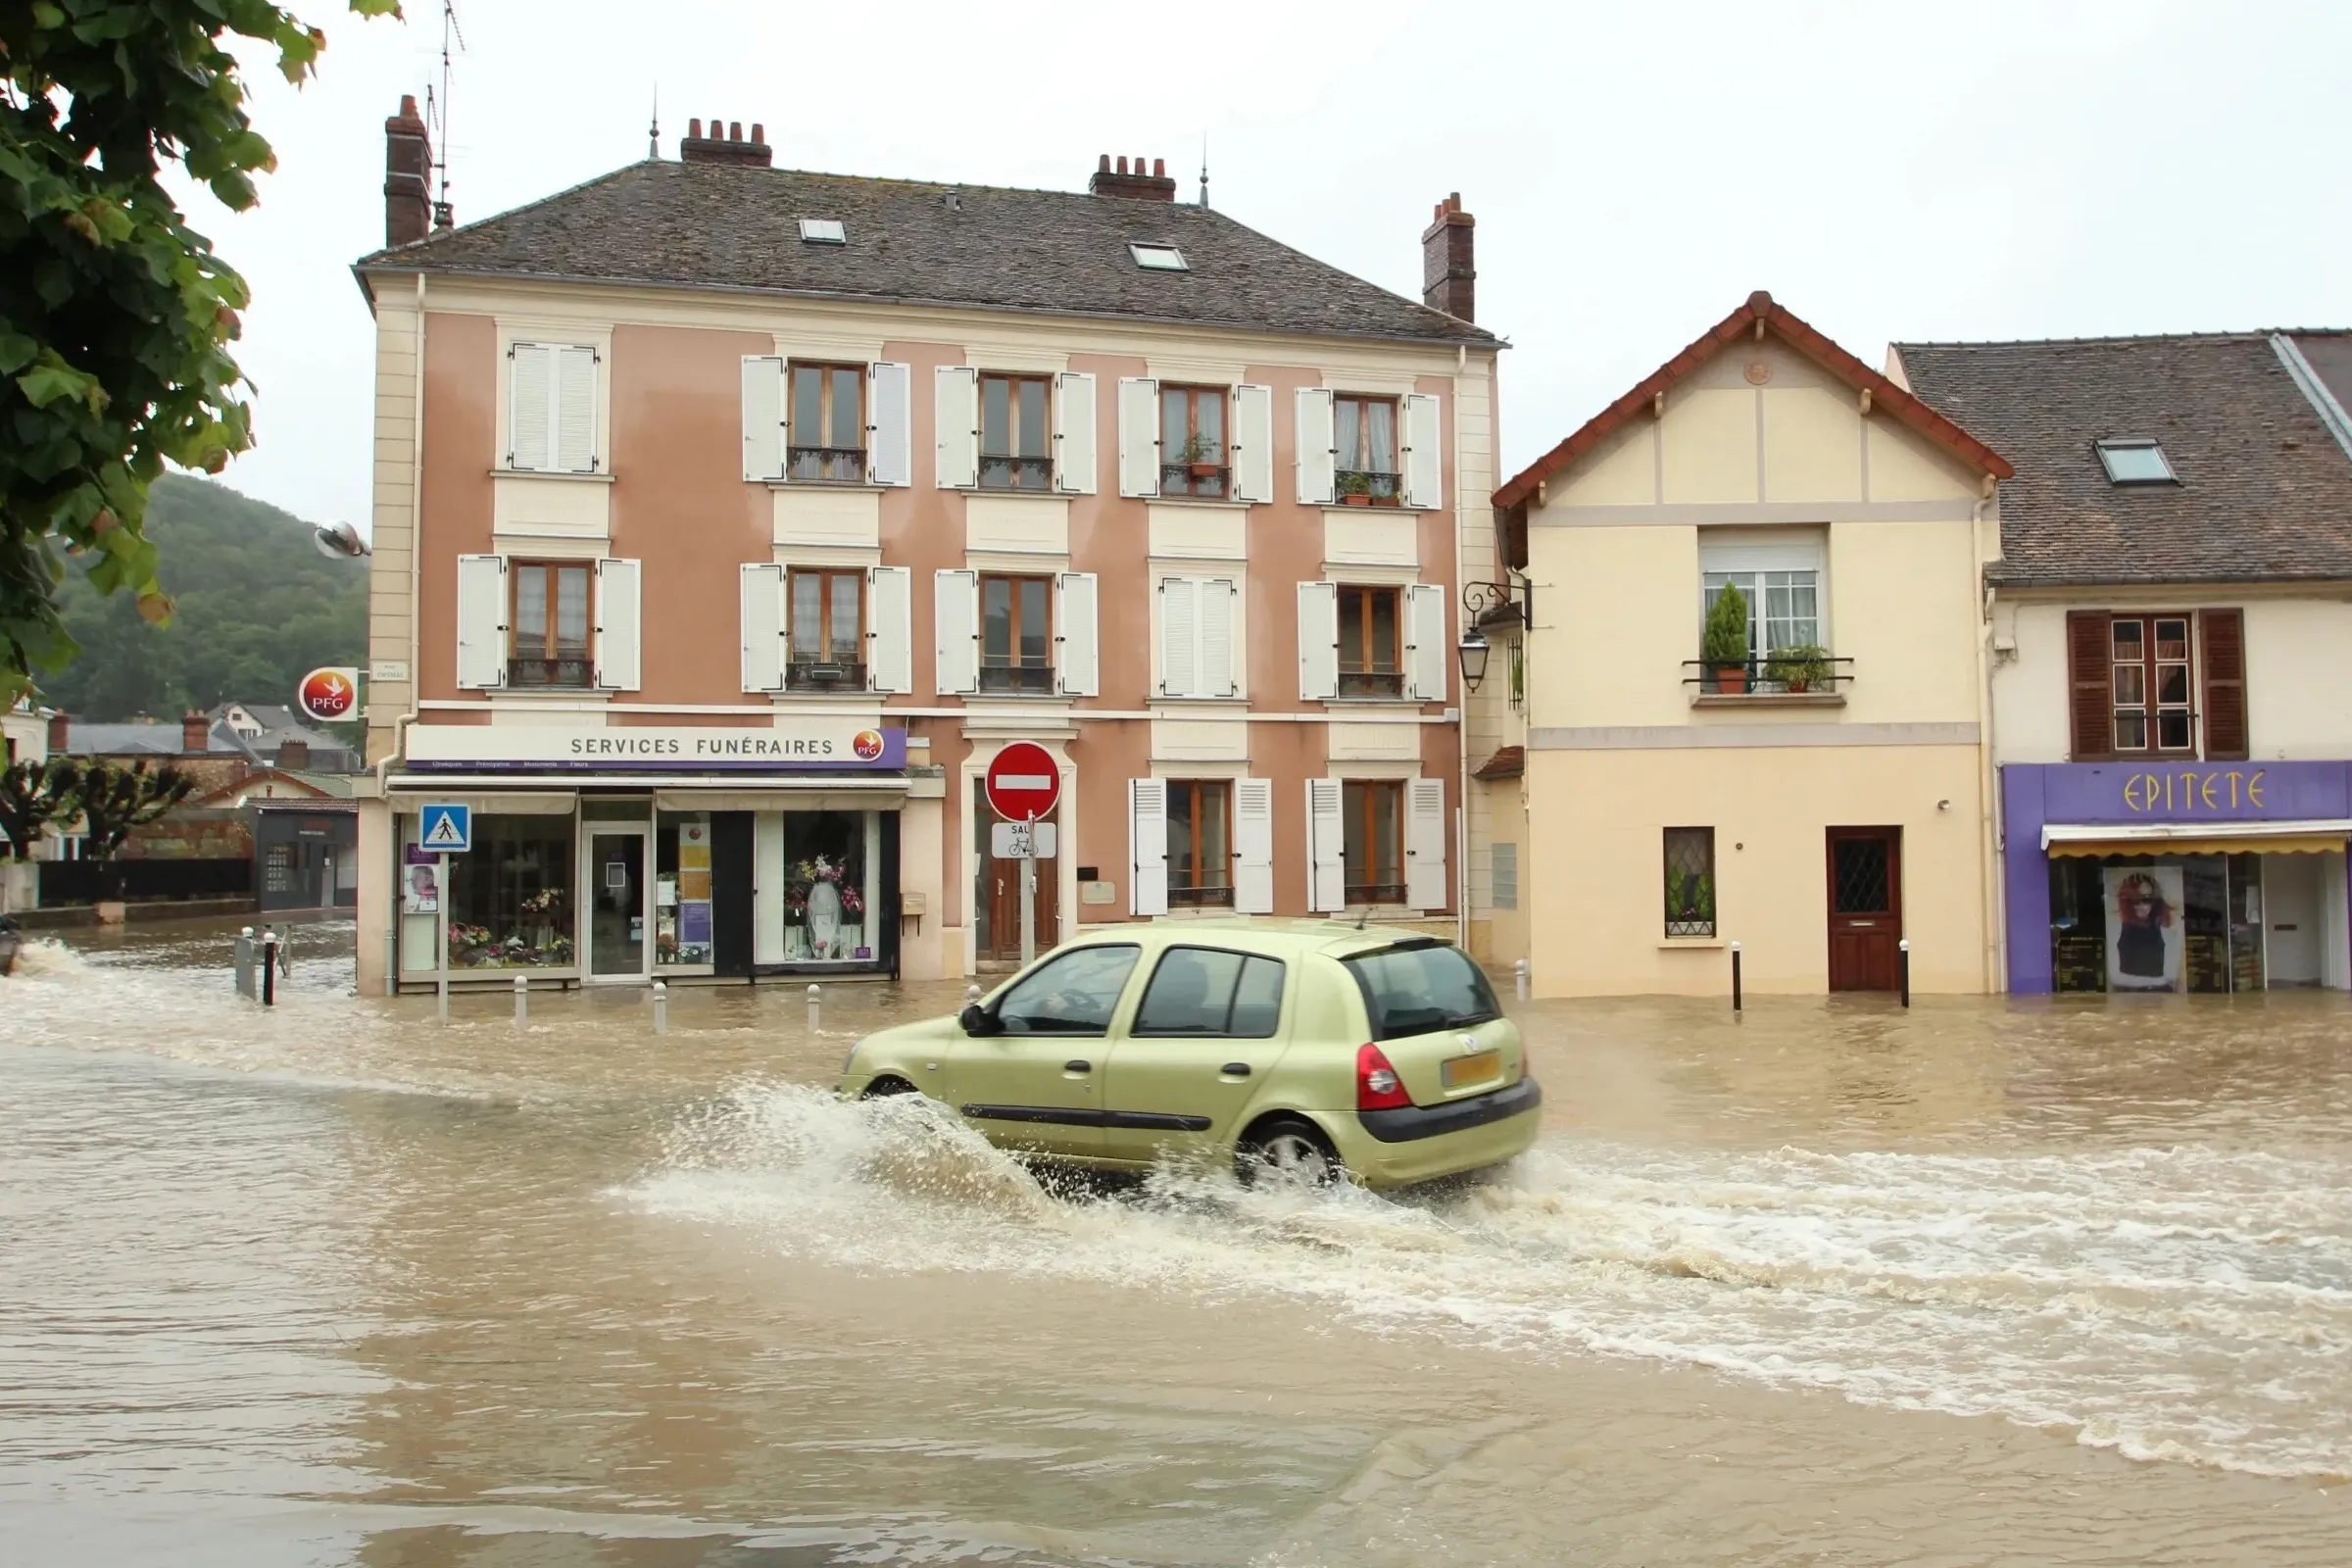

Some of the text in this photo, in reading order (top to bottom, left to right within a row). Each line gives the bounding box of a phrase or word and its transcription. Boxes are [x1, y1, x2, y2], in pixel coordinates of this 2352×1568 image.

[313, 697, 344, 710] PFG
[570, 736, 833, 754] SERVICES FUNÉRAIRES
[858, 746, 877, 755] PFG
[2124, 771, 2266, 811] EPITETE
[1011, 825, 1030, 835] SAU
